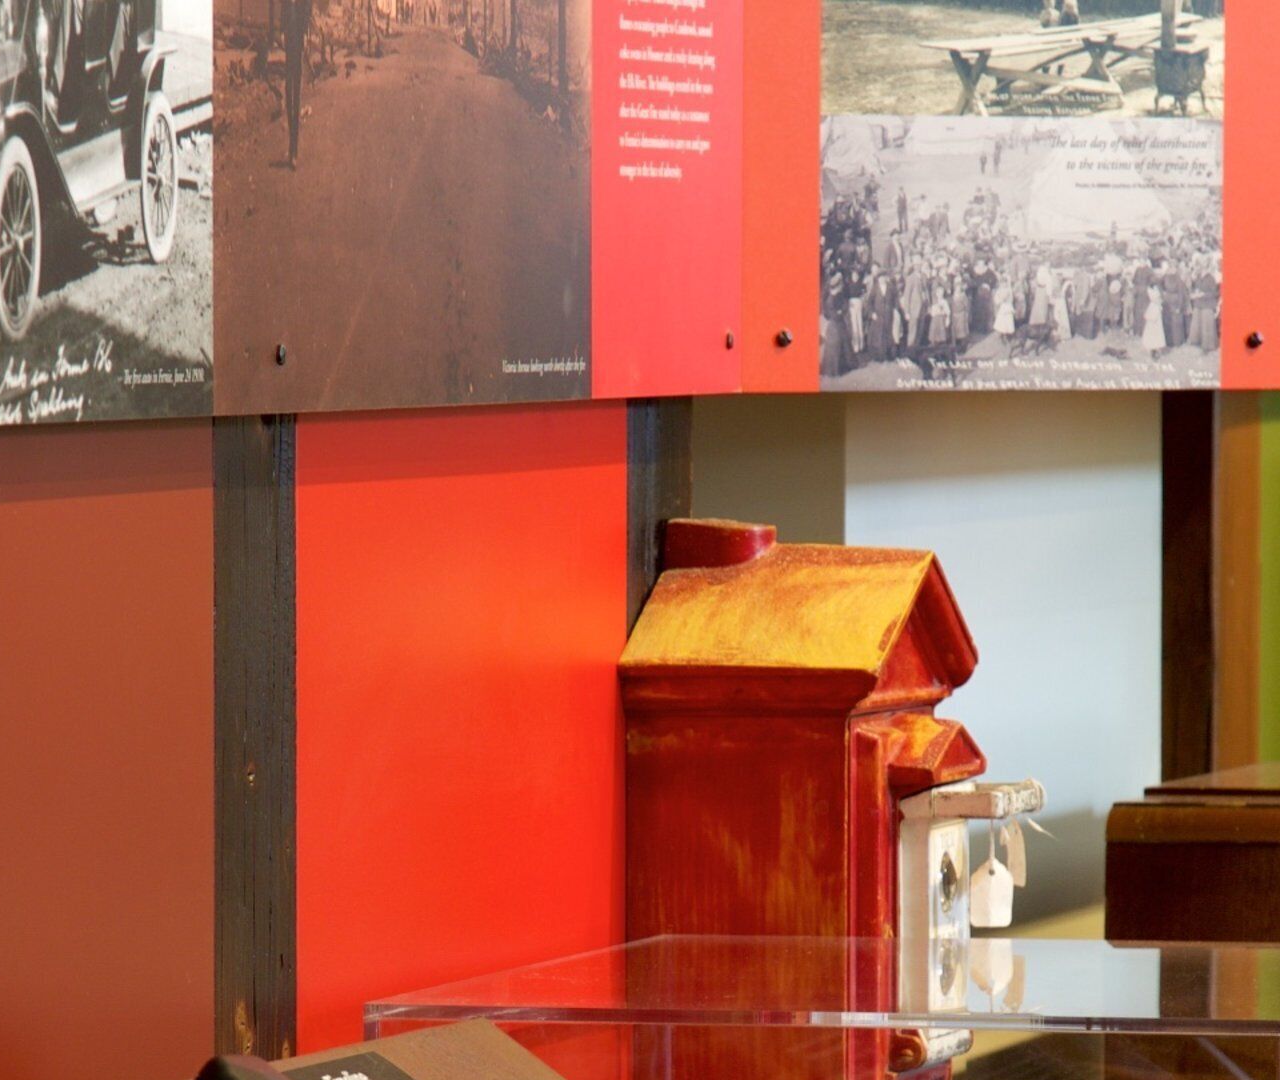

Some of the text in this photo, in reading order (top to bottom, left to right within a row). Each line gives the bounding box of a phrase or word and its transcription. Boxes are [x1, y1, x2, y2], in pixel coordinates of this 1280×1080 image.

[1051, 135, 1068, 149] The
[1070, 136, 1087, 149] last
[1089, 135, 1107, 152] day
[1110, 135, 1123, 152] of
[1150, 135, 1208, 149] distribution
[1066, 160, 1076, 171] to
[1079, 158, 1093, 171] the
[1097, 159, 1131, 171] victims
[1134, 158, 1147, 175] of
[1147, 158, 1163, 171] the
[1164, 160, 1189, 174] great
